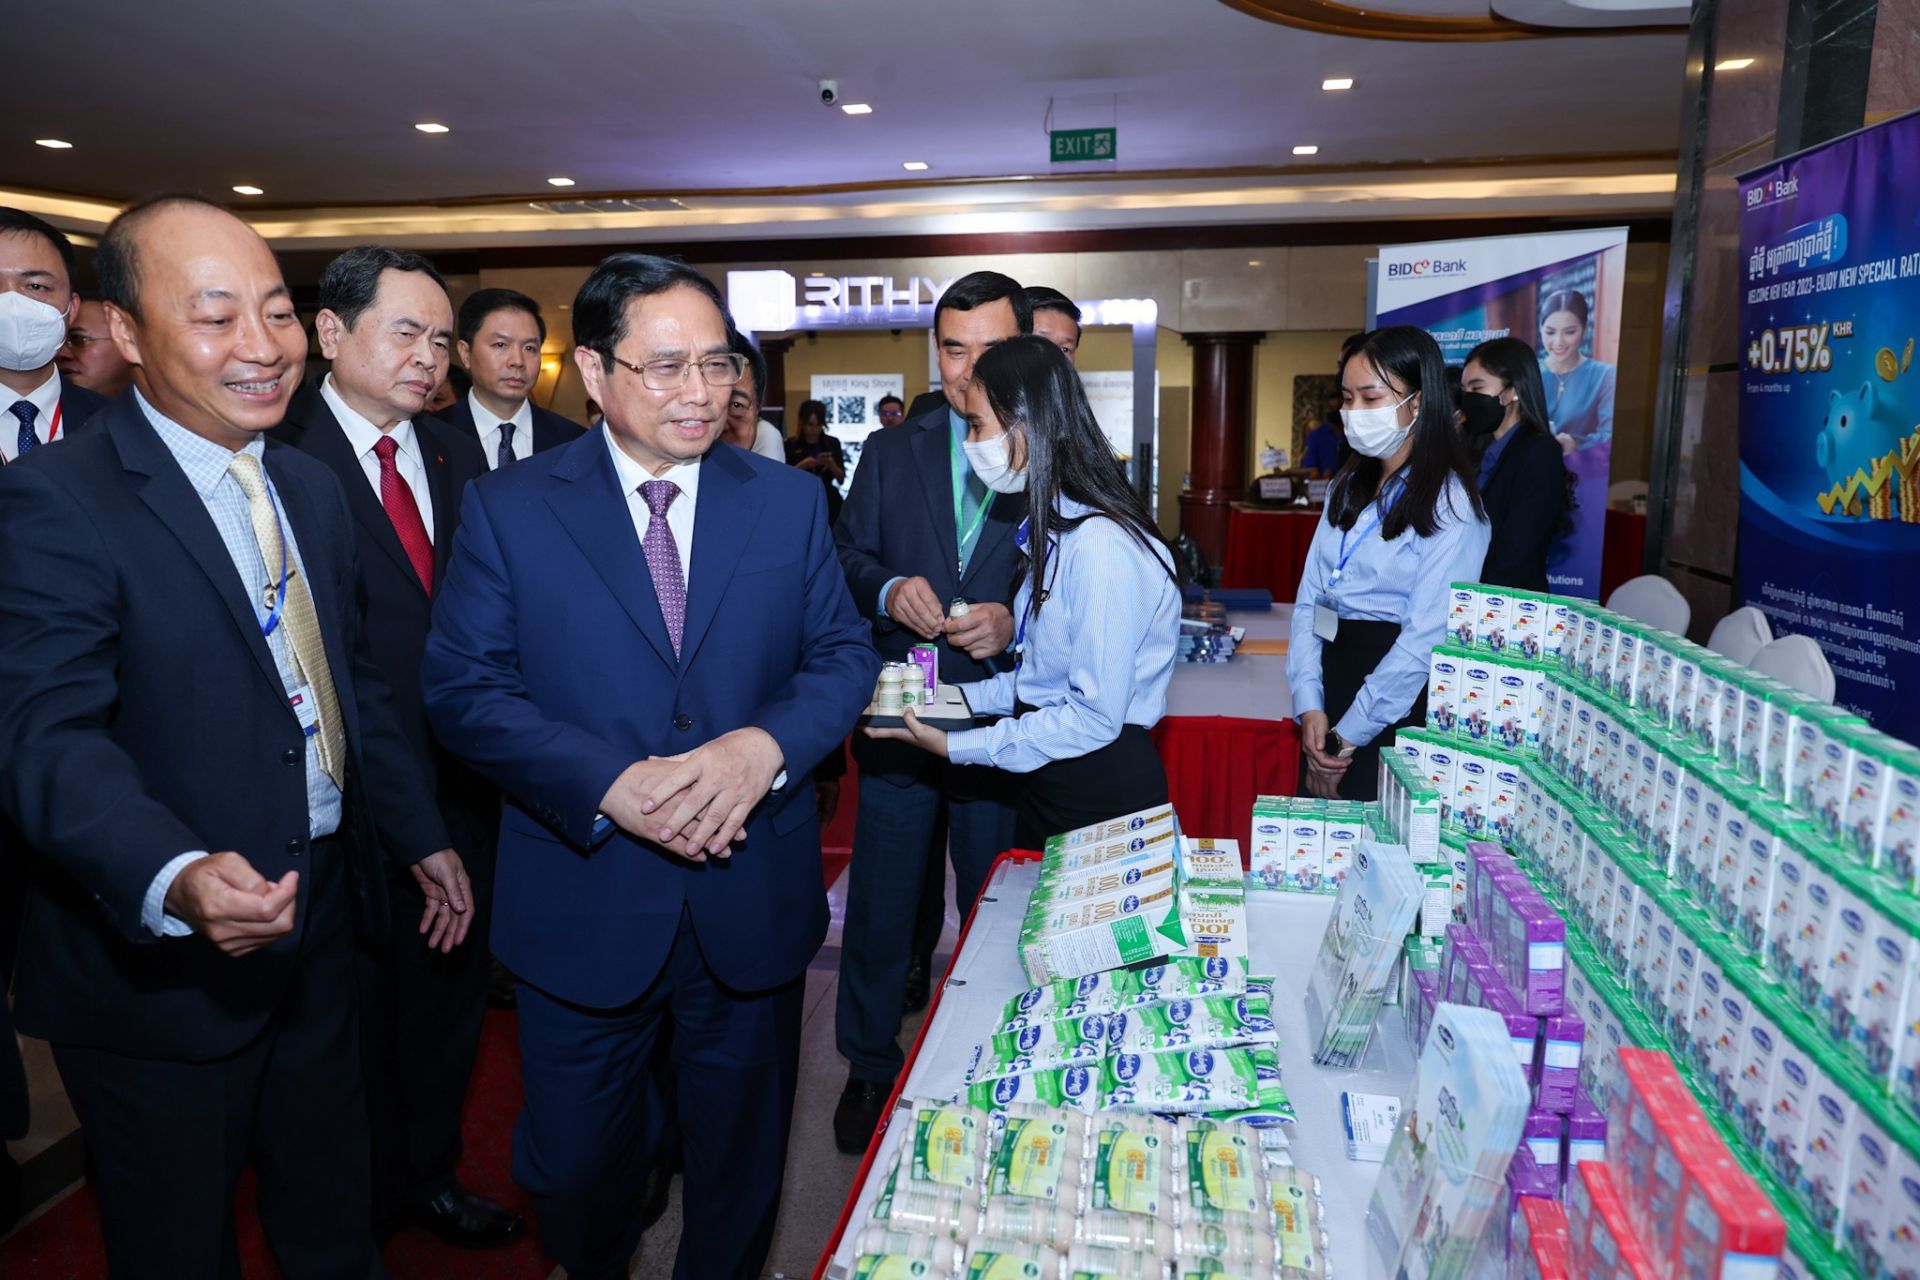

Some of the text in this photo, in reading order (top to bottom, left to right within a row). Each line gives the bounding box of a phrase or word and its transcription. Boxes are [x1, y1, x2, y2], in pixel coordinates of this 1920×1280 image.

[1055, 135, 1092, 155] EXIT
[1775, 175, 1799, 198] Bank
[1388, 258, 1467, 276] BIDC Bank
[1781, 279, 1797, 298] YEAR
[1816, 270, 1838, 293] ENJOY
[1839, 266, 1858, 288] NEW
[1858, 257, 1897, 285] SPECIAL
[804, 276, 954, 313] RITHY
[1748, 321, 1853, 373] +0.75% KHR
[851, 380, 869, 389] King
[871, 379, 896, 388] Stone
[1764, 382, 1783, 393] months
[1784, 384, 1791, 395] up
